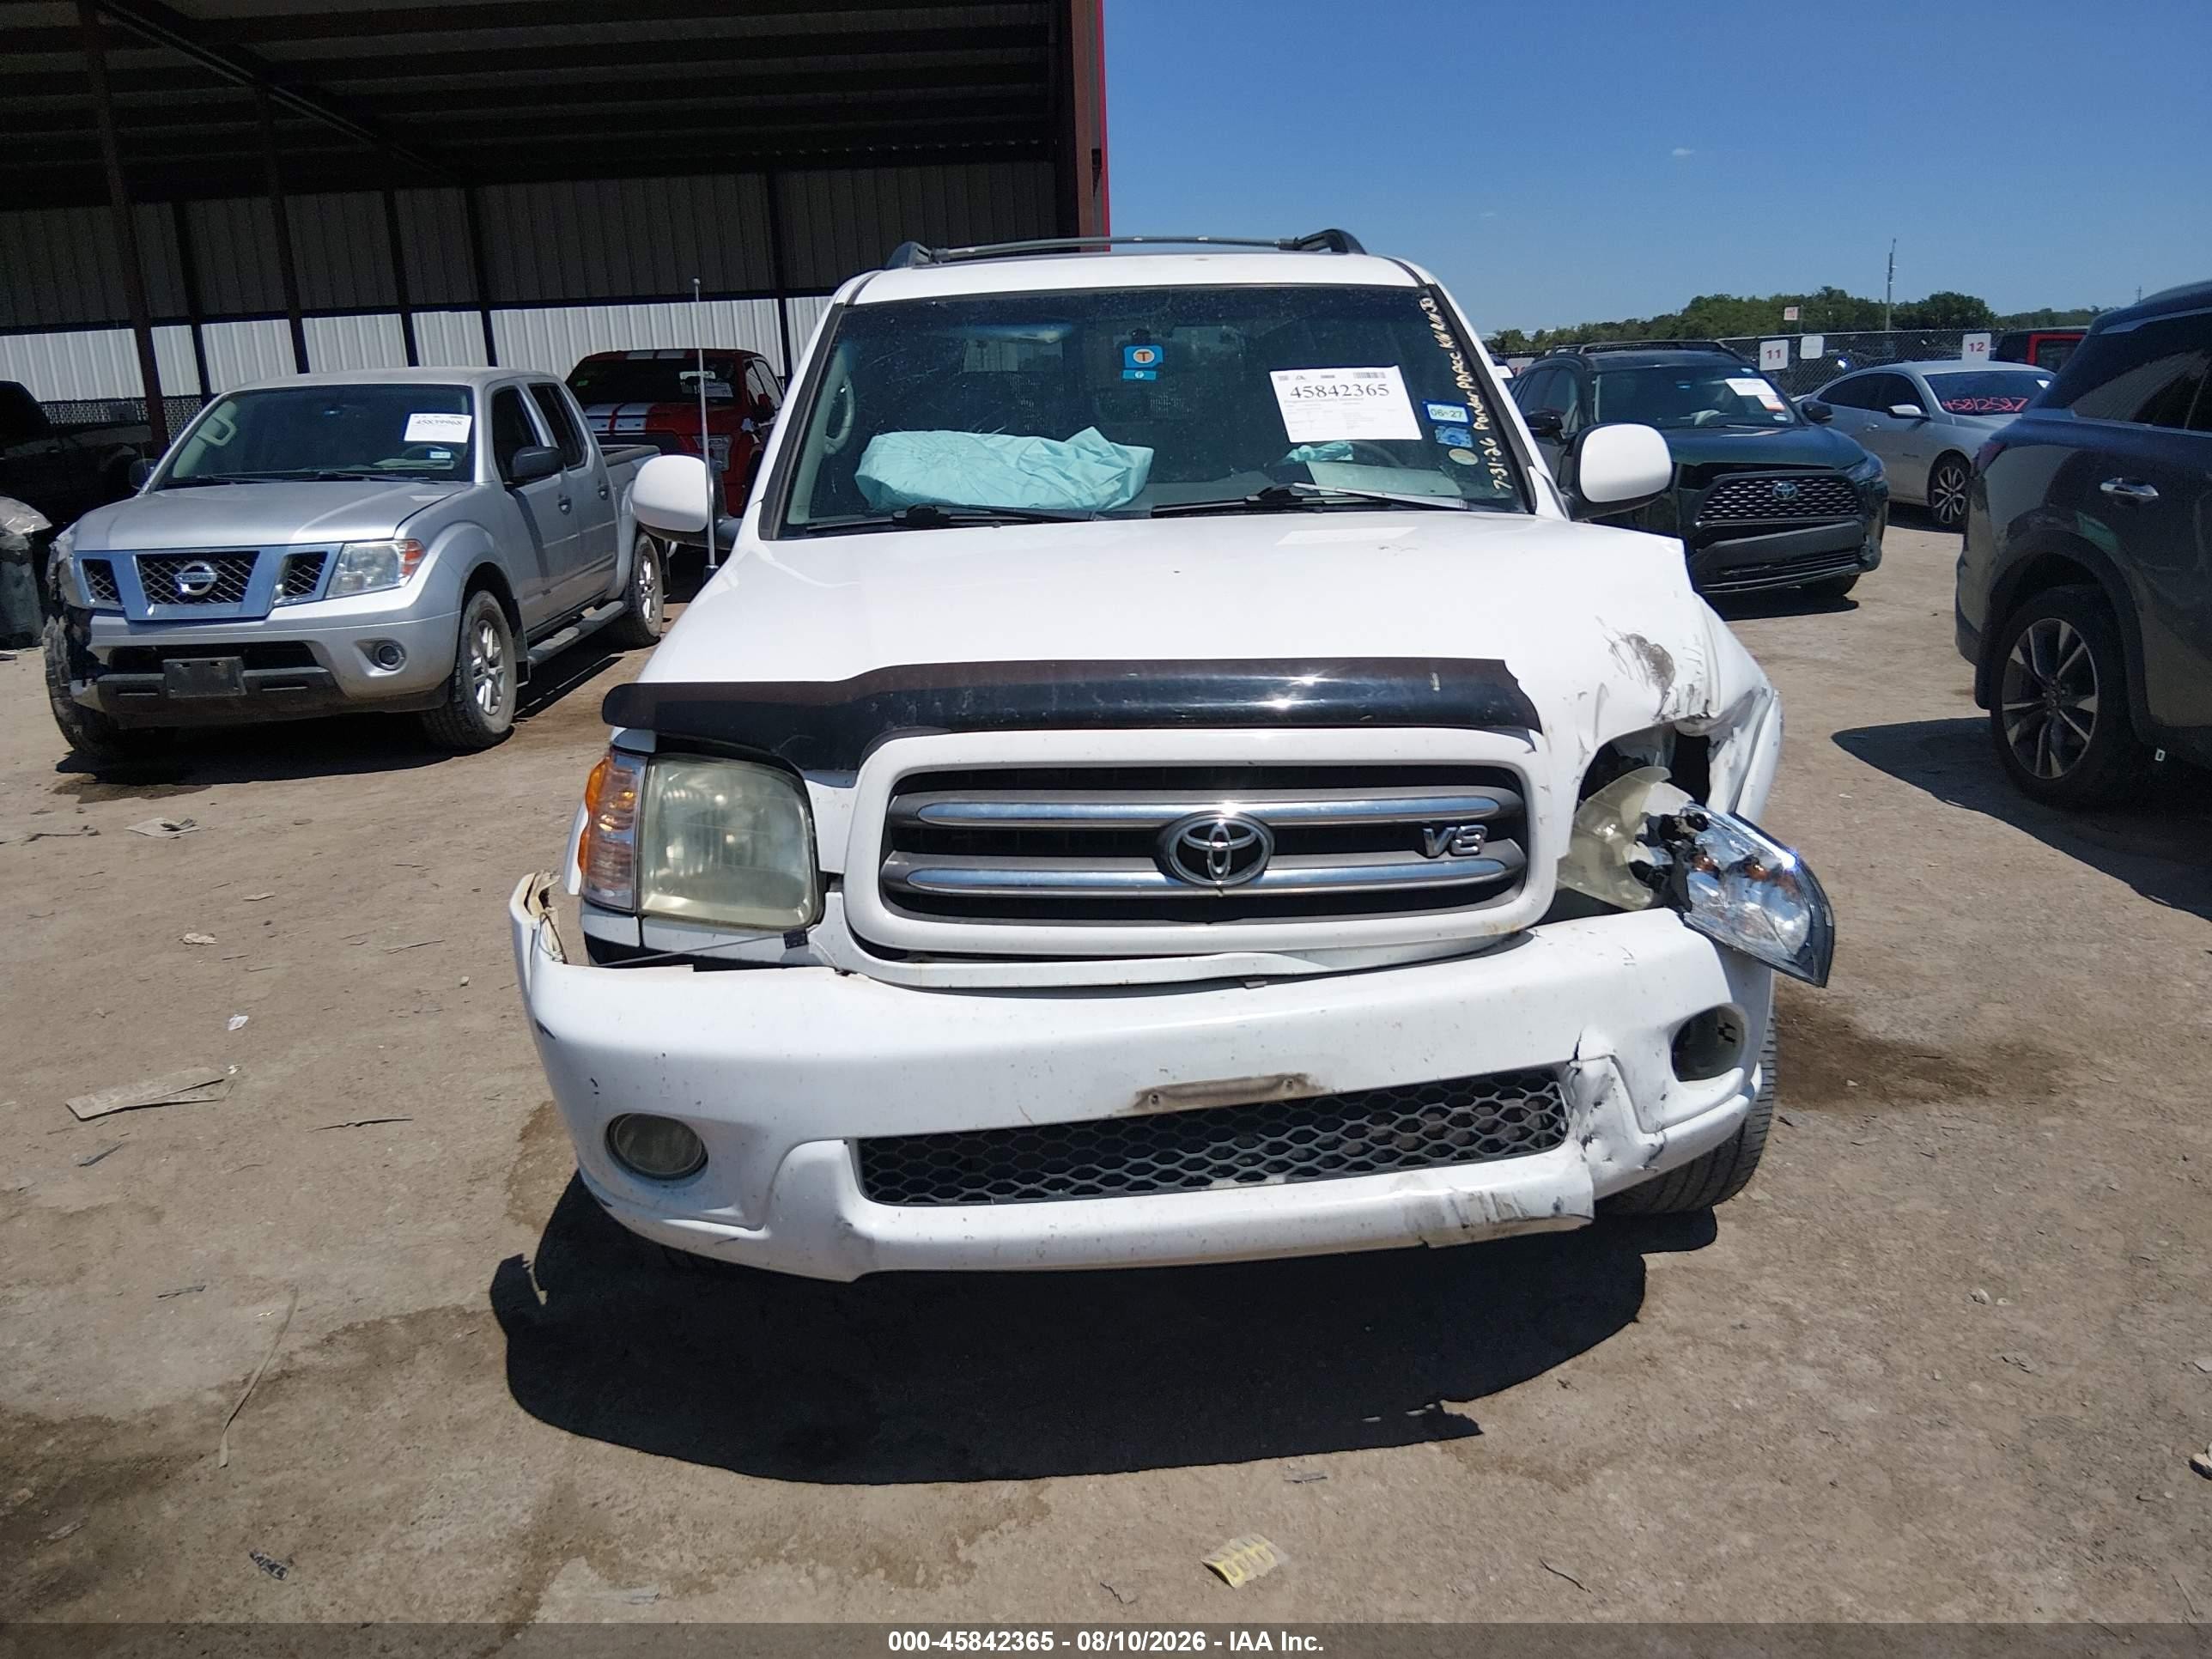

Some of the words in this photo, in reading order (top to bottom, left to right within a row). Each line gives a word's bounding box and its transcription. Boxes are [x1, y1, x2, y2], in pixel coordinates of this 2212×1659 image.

[1969, 342, 1984, 352] 12
[1766, 349, 1782, 359] 11
[1290, 383, 1390, 399] 45842365
[1430, 408, 1463, 419] 06-27
[1423, 824, 1487, 858] V8
